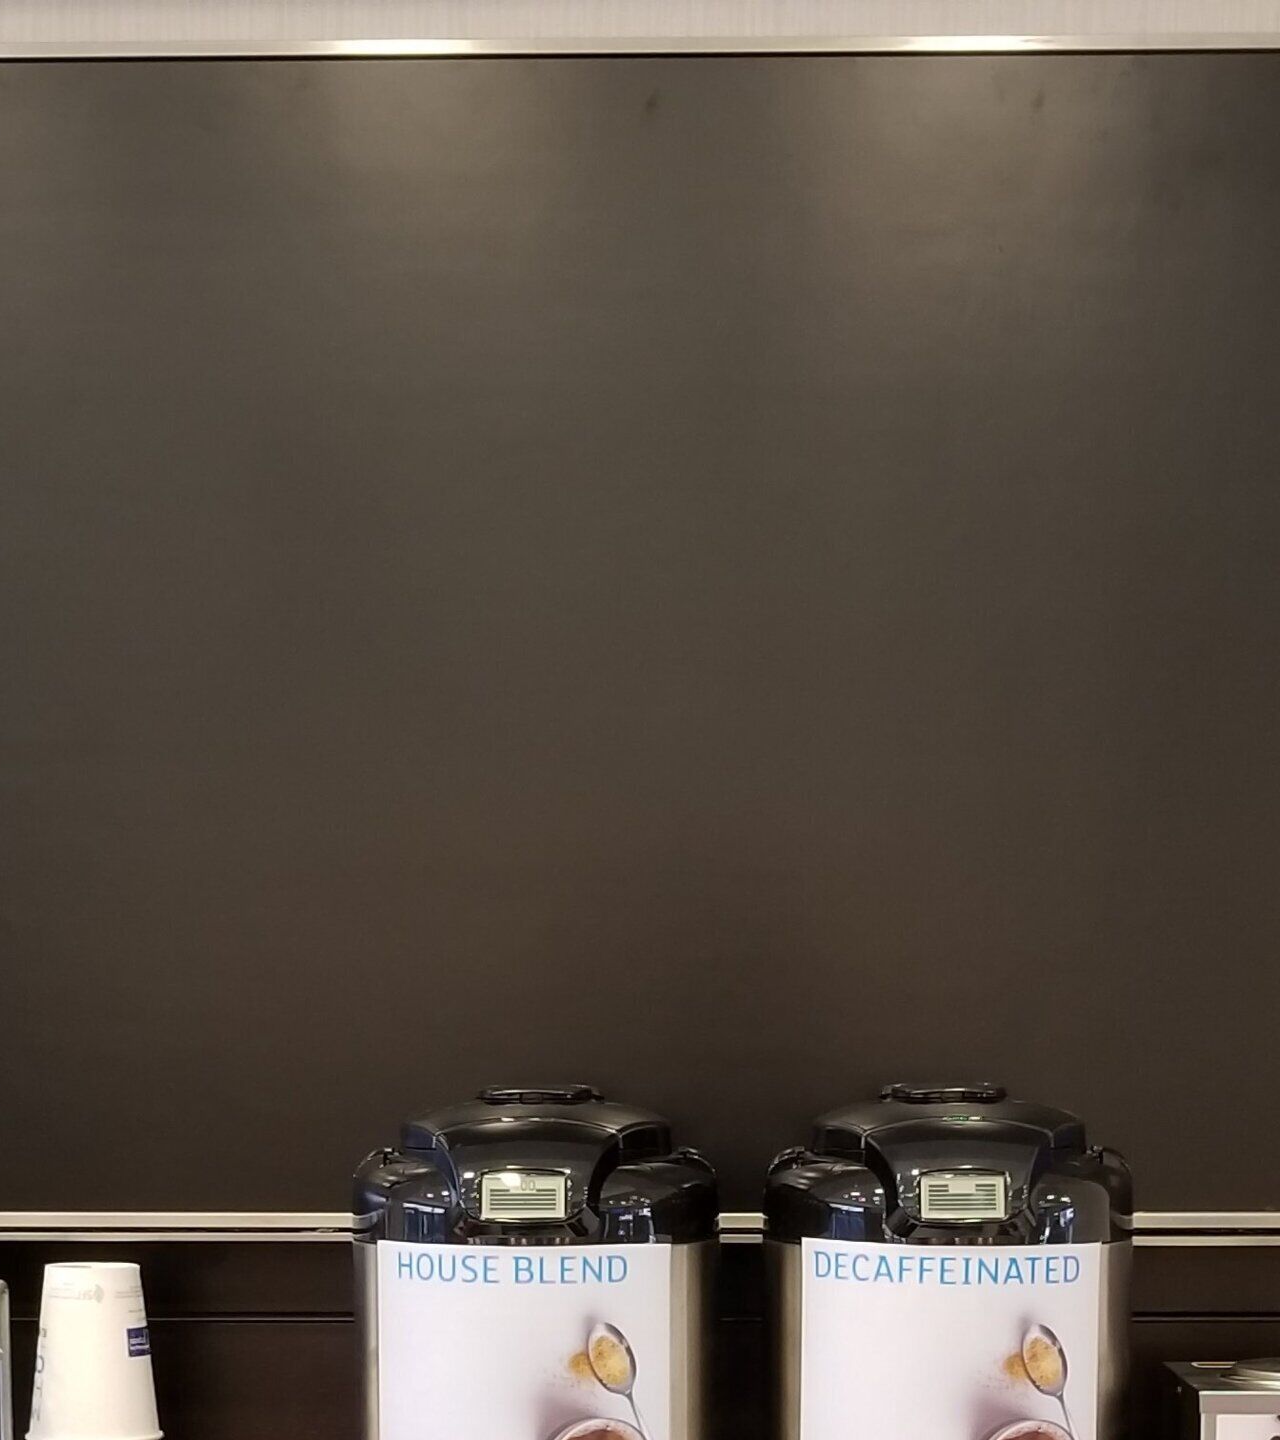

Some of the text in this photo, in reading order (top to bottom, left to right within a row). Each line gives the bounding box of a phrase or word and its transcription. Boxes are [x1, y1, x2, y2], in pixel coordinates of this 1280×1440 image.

[397, 1252, 628, 1284] HOUSE BLEND
[813, 1250, 1081, 1285] DECAFFEINATED
